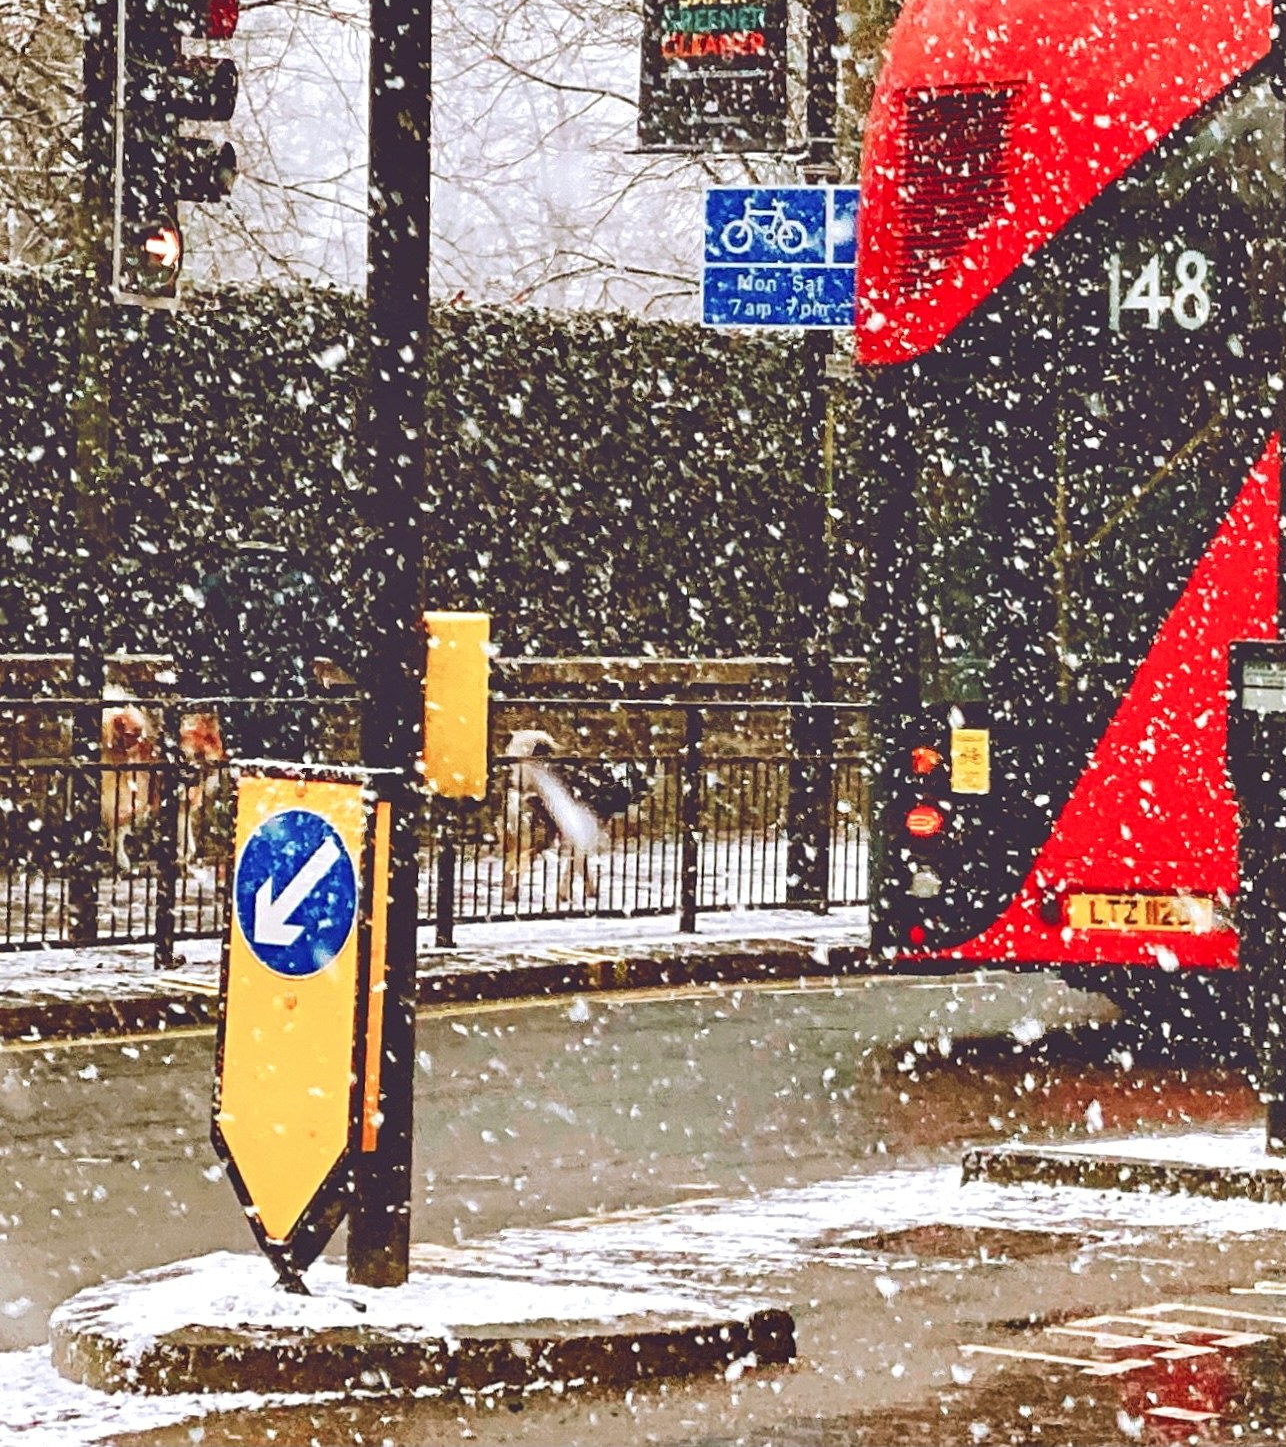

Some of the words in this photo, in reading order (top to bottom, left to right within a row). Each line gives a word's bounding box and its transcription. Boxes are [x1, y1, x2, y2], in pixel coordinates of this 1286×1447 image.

[737, 275, 777, 292] Mon
[792, 274, 825, 292] Sat
[1108, 250, 1211, 331] 148
[1089, 899, 1138, 925] LTZ
[1145, 899, 1192, 926] 112
